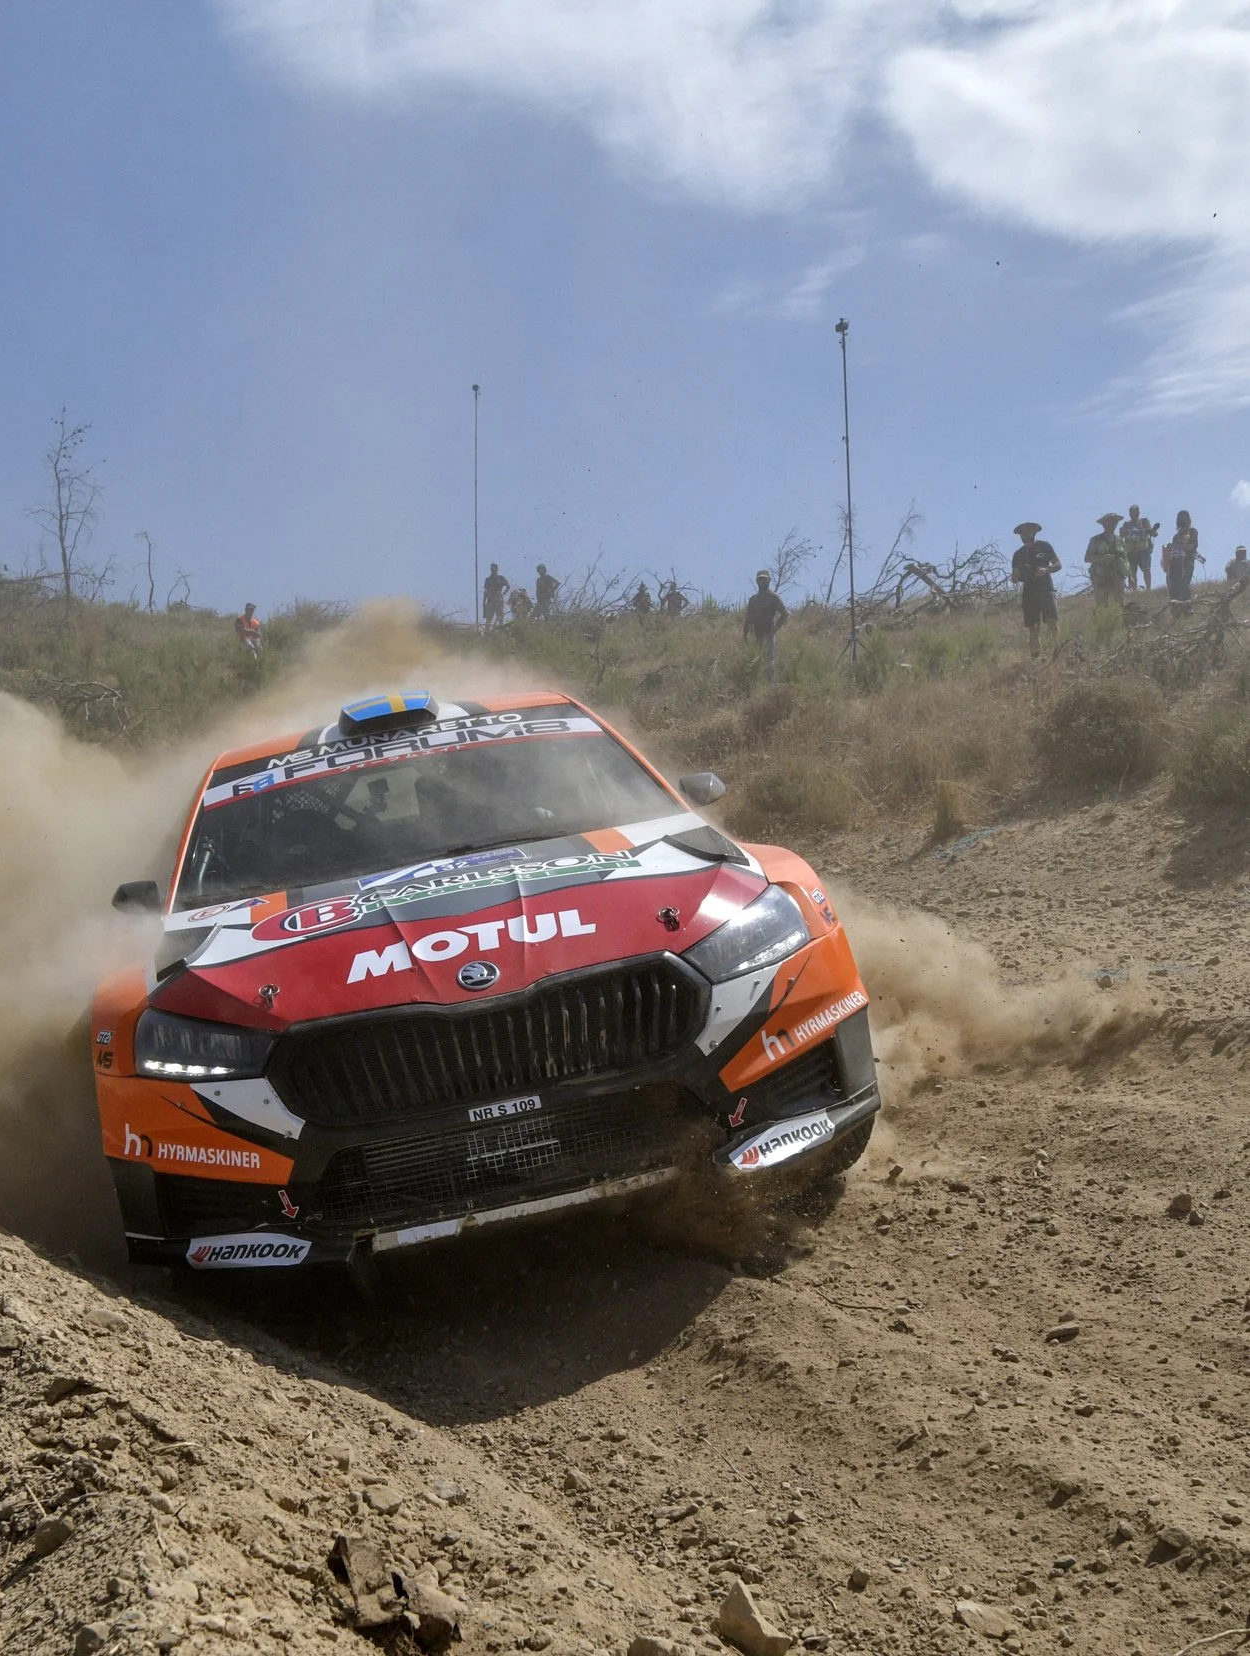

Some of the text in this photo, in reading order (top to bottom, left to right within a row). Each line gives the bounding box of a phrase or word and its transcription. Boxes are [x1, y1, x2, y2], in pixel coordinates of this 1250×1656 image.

[267, 713, 522, 770] MS MUNARETTO
[283, 719, 571, 780] FORUM8
[357, 850, 633, 905] CARLSSON
[441, 861, 468, 871] 32
[281, 896, 361, 932] B
[347, 909, 597, 984] MOTUL
[794, 990, 868, 1042] HYRMASKINER
[472, 1099, 536, 1120] NR S 109
[157, 1142, 261, 1169] HYRMASKINER
